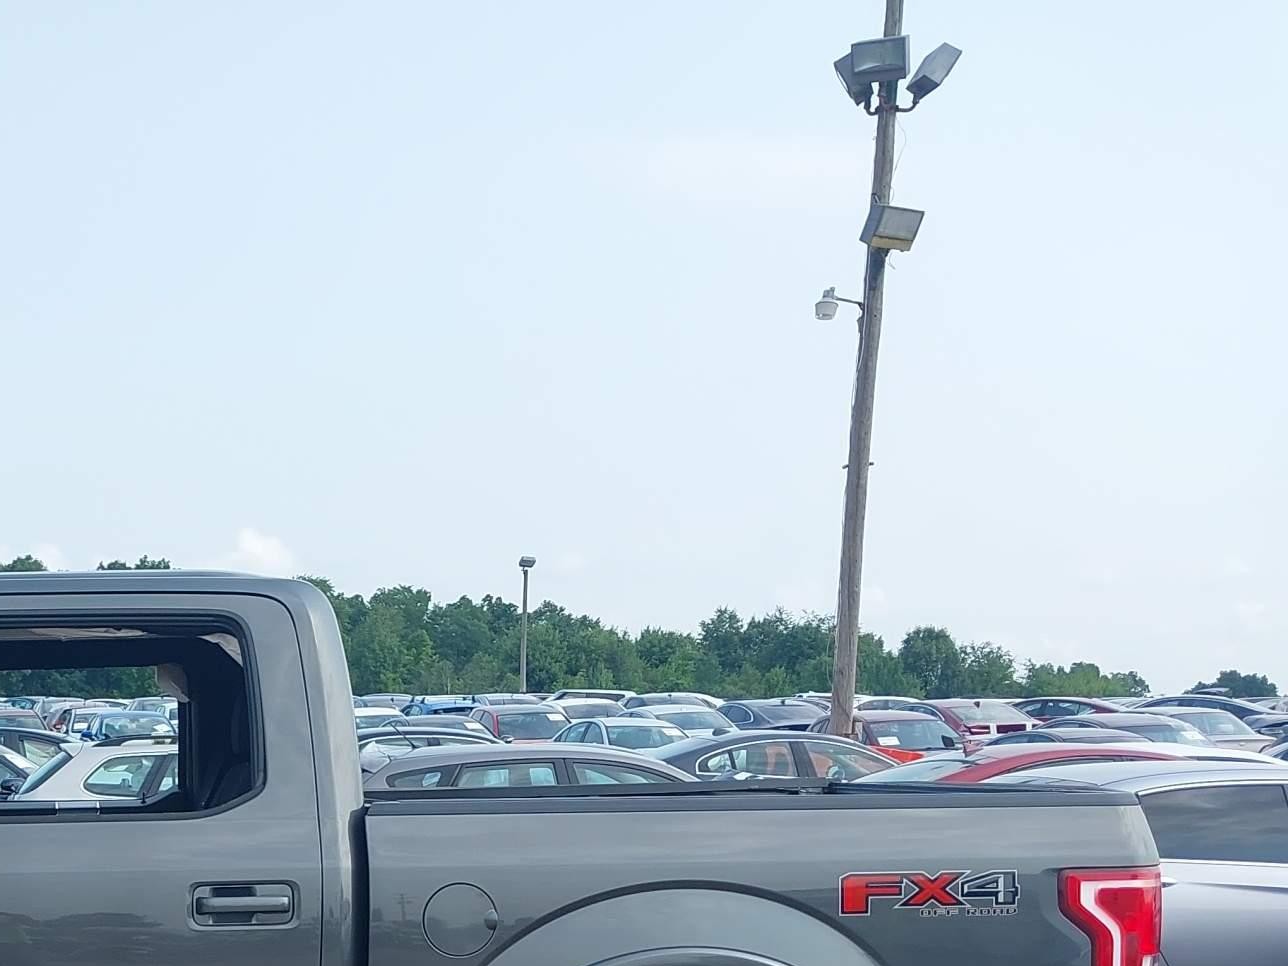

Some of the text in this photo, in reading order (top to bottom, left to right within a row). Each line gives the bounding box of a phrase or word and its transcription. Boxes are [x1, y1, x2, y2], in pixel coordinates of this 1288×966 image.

[839, 870, 1020, 916] FX4
[920, 907, 1018, 917] OFF ROAD
